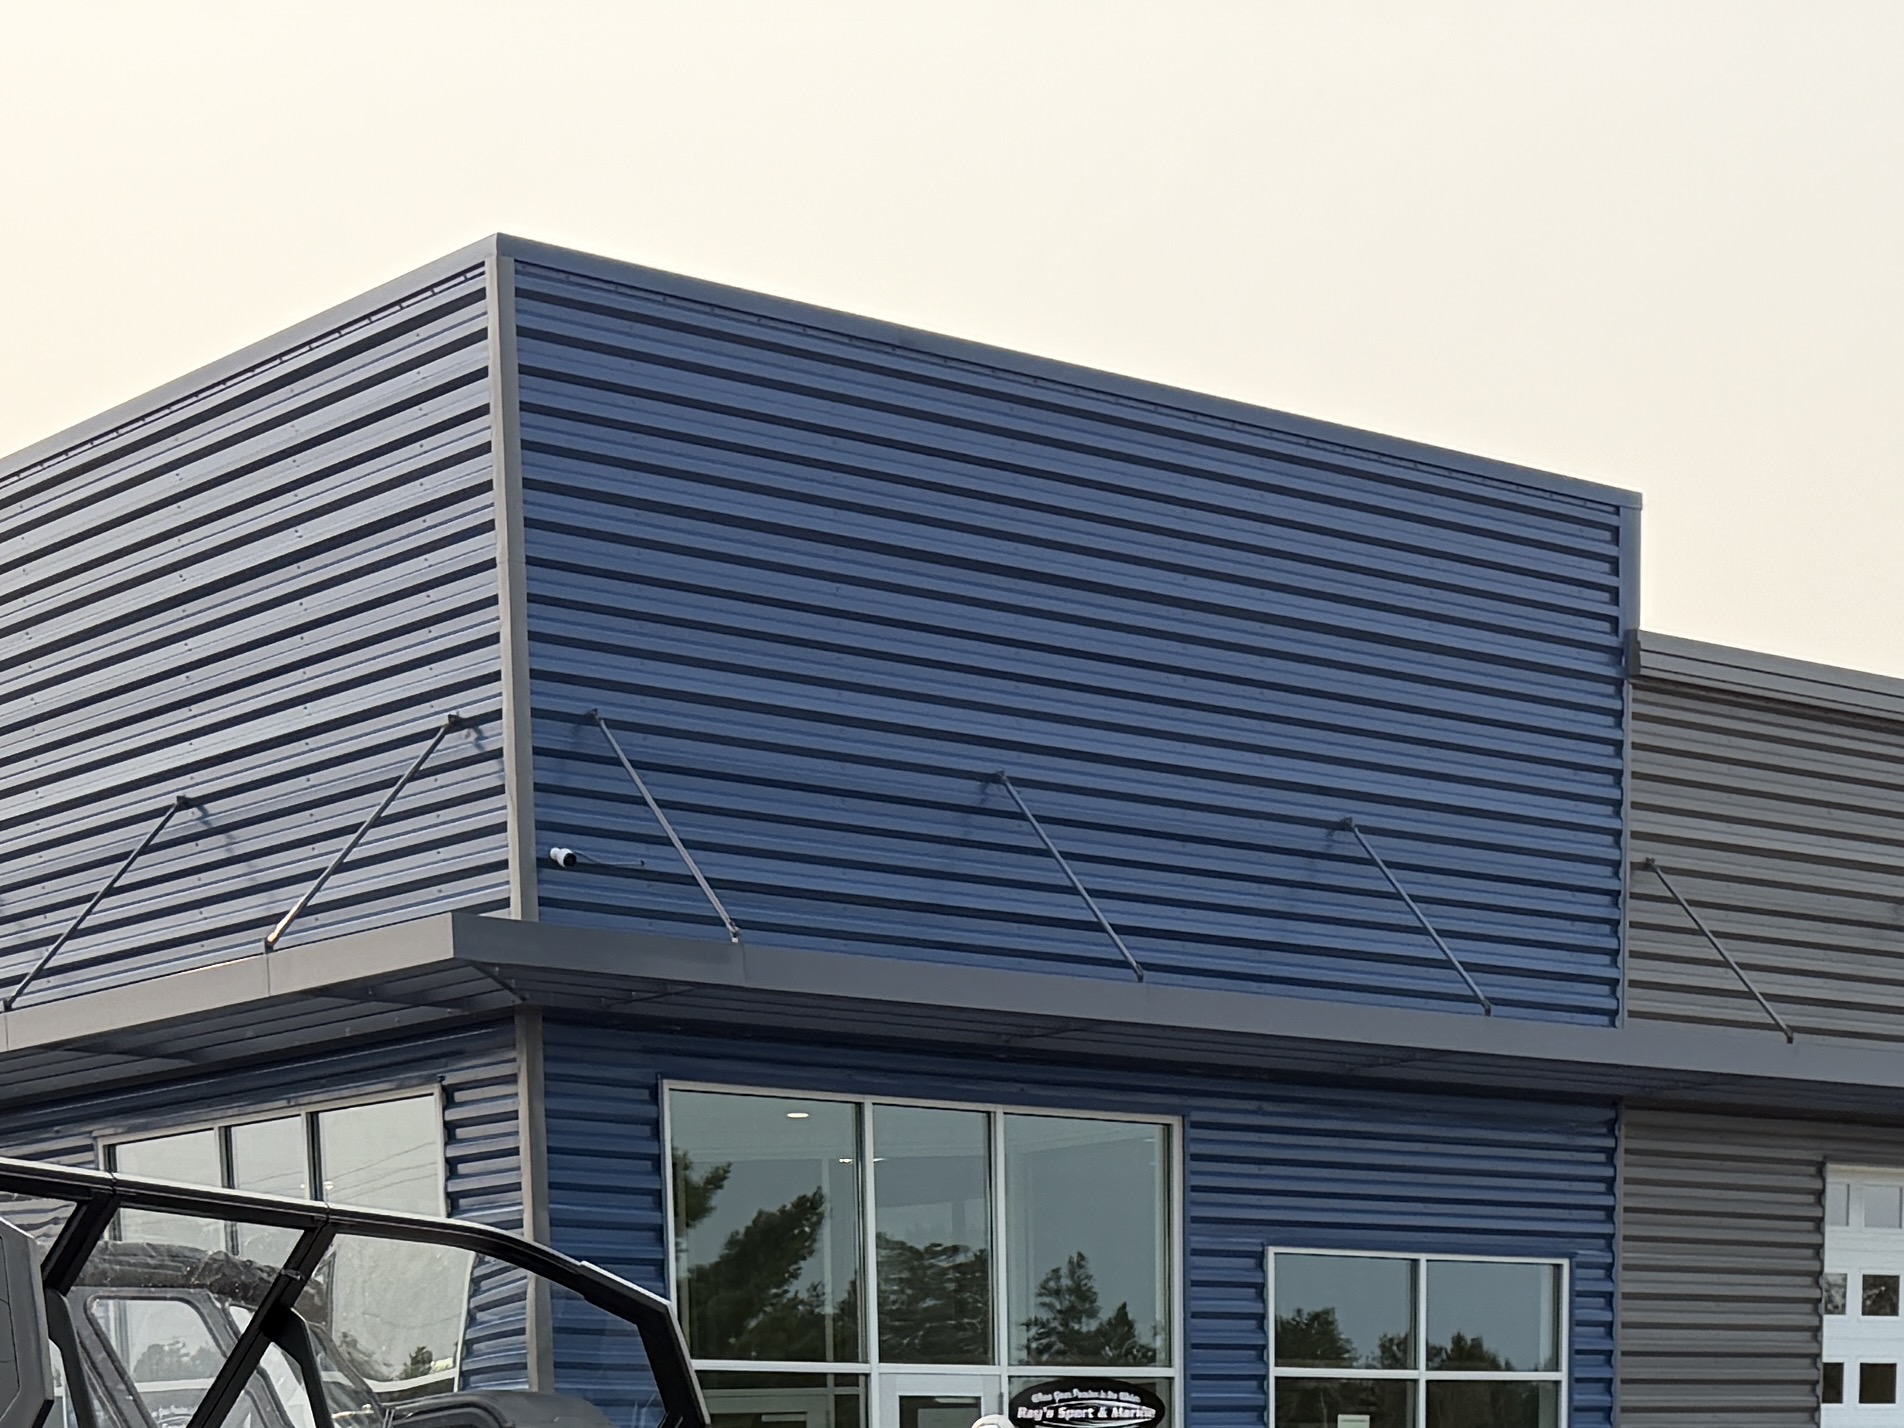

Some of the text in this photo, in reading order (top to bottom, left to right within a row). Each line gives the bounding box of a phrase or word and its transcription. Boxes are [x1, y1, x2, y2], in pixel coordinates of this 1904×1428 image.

[1017, 1406, 1156, 1421] Ray's Sport & Marine
